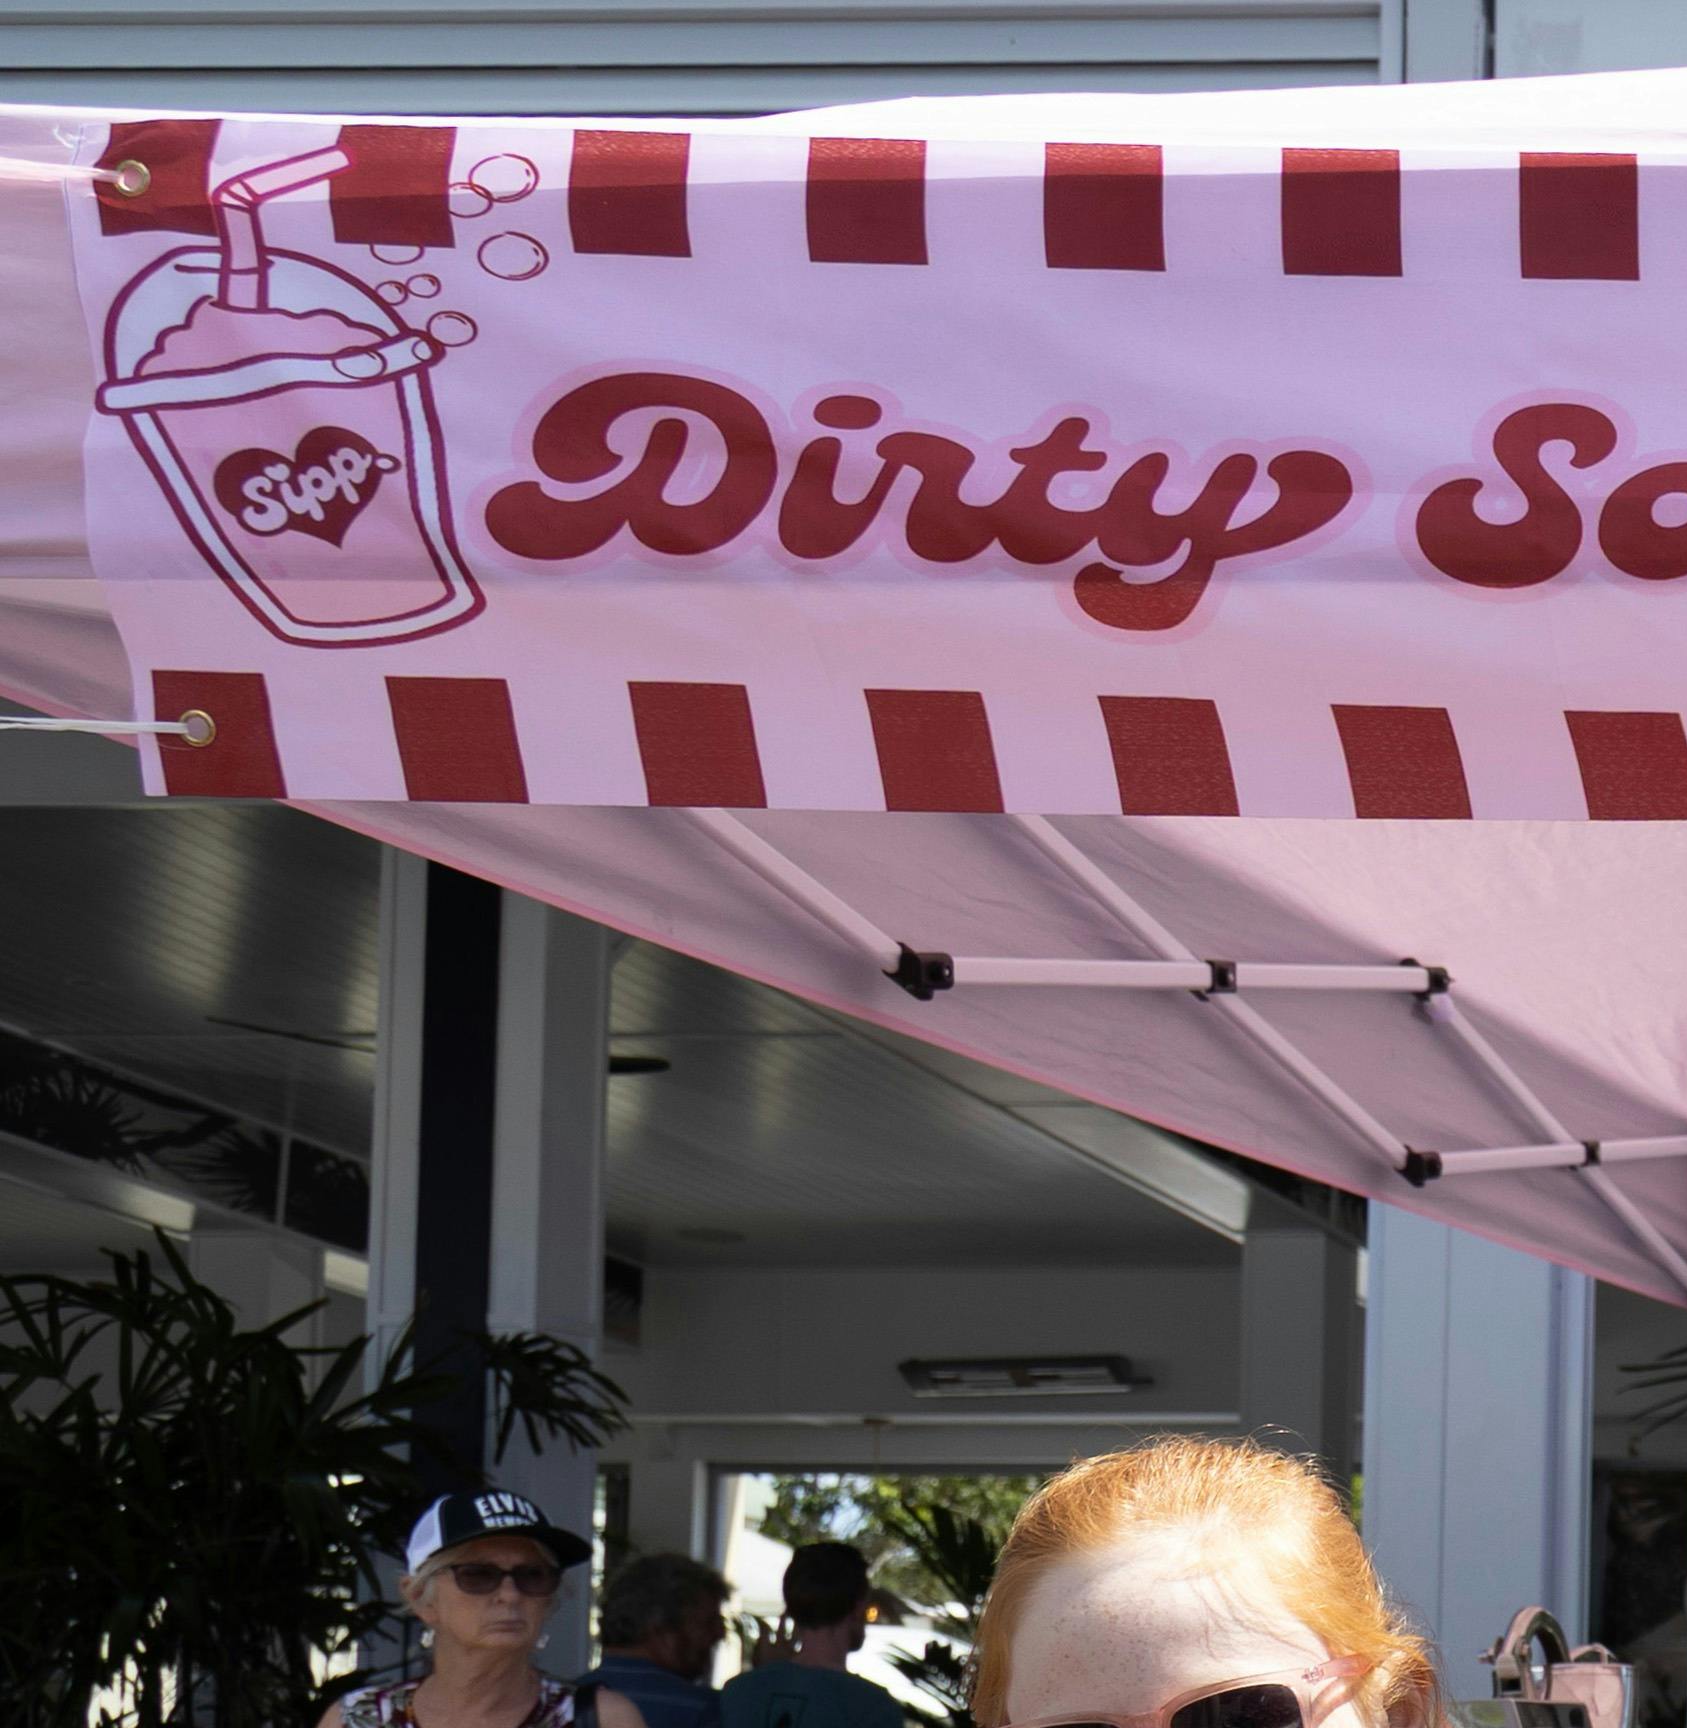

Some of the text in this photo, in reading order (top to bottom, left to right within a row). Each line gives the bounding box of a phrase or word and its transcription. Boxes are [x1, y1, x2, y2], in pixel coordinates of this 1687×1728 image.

[243, 449, 400, 535] Sipp.
[484, 372, 1353, 632] Dirty
[474, 1491, 540, 1522] ELVIS
